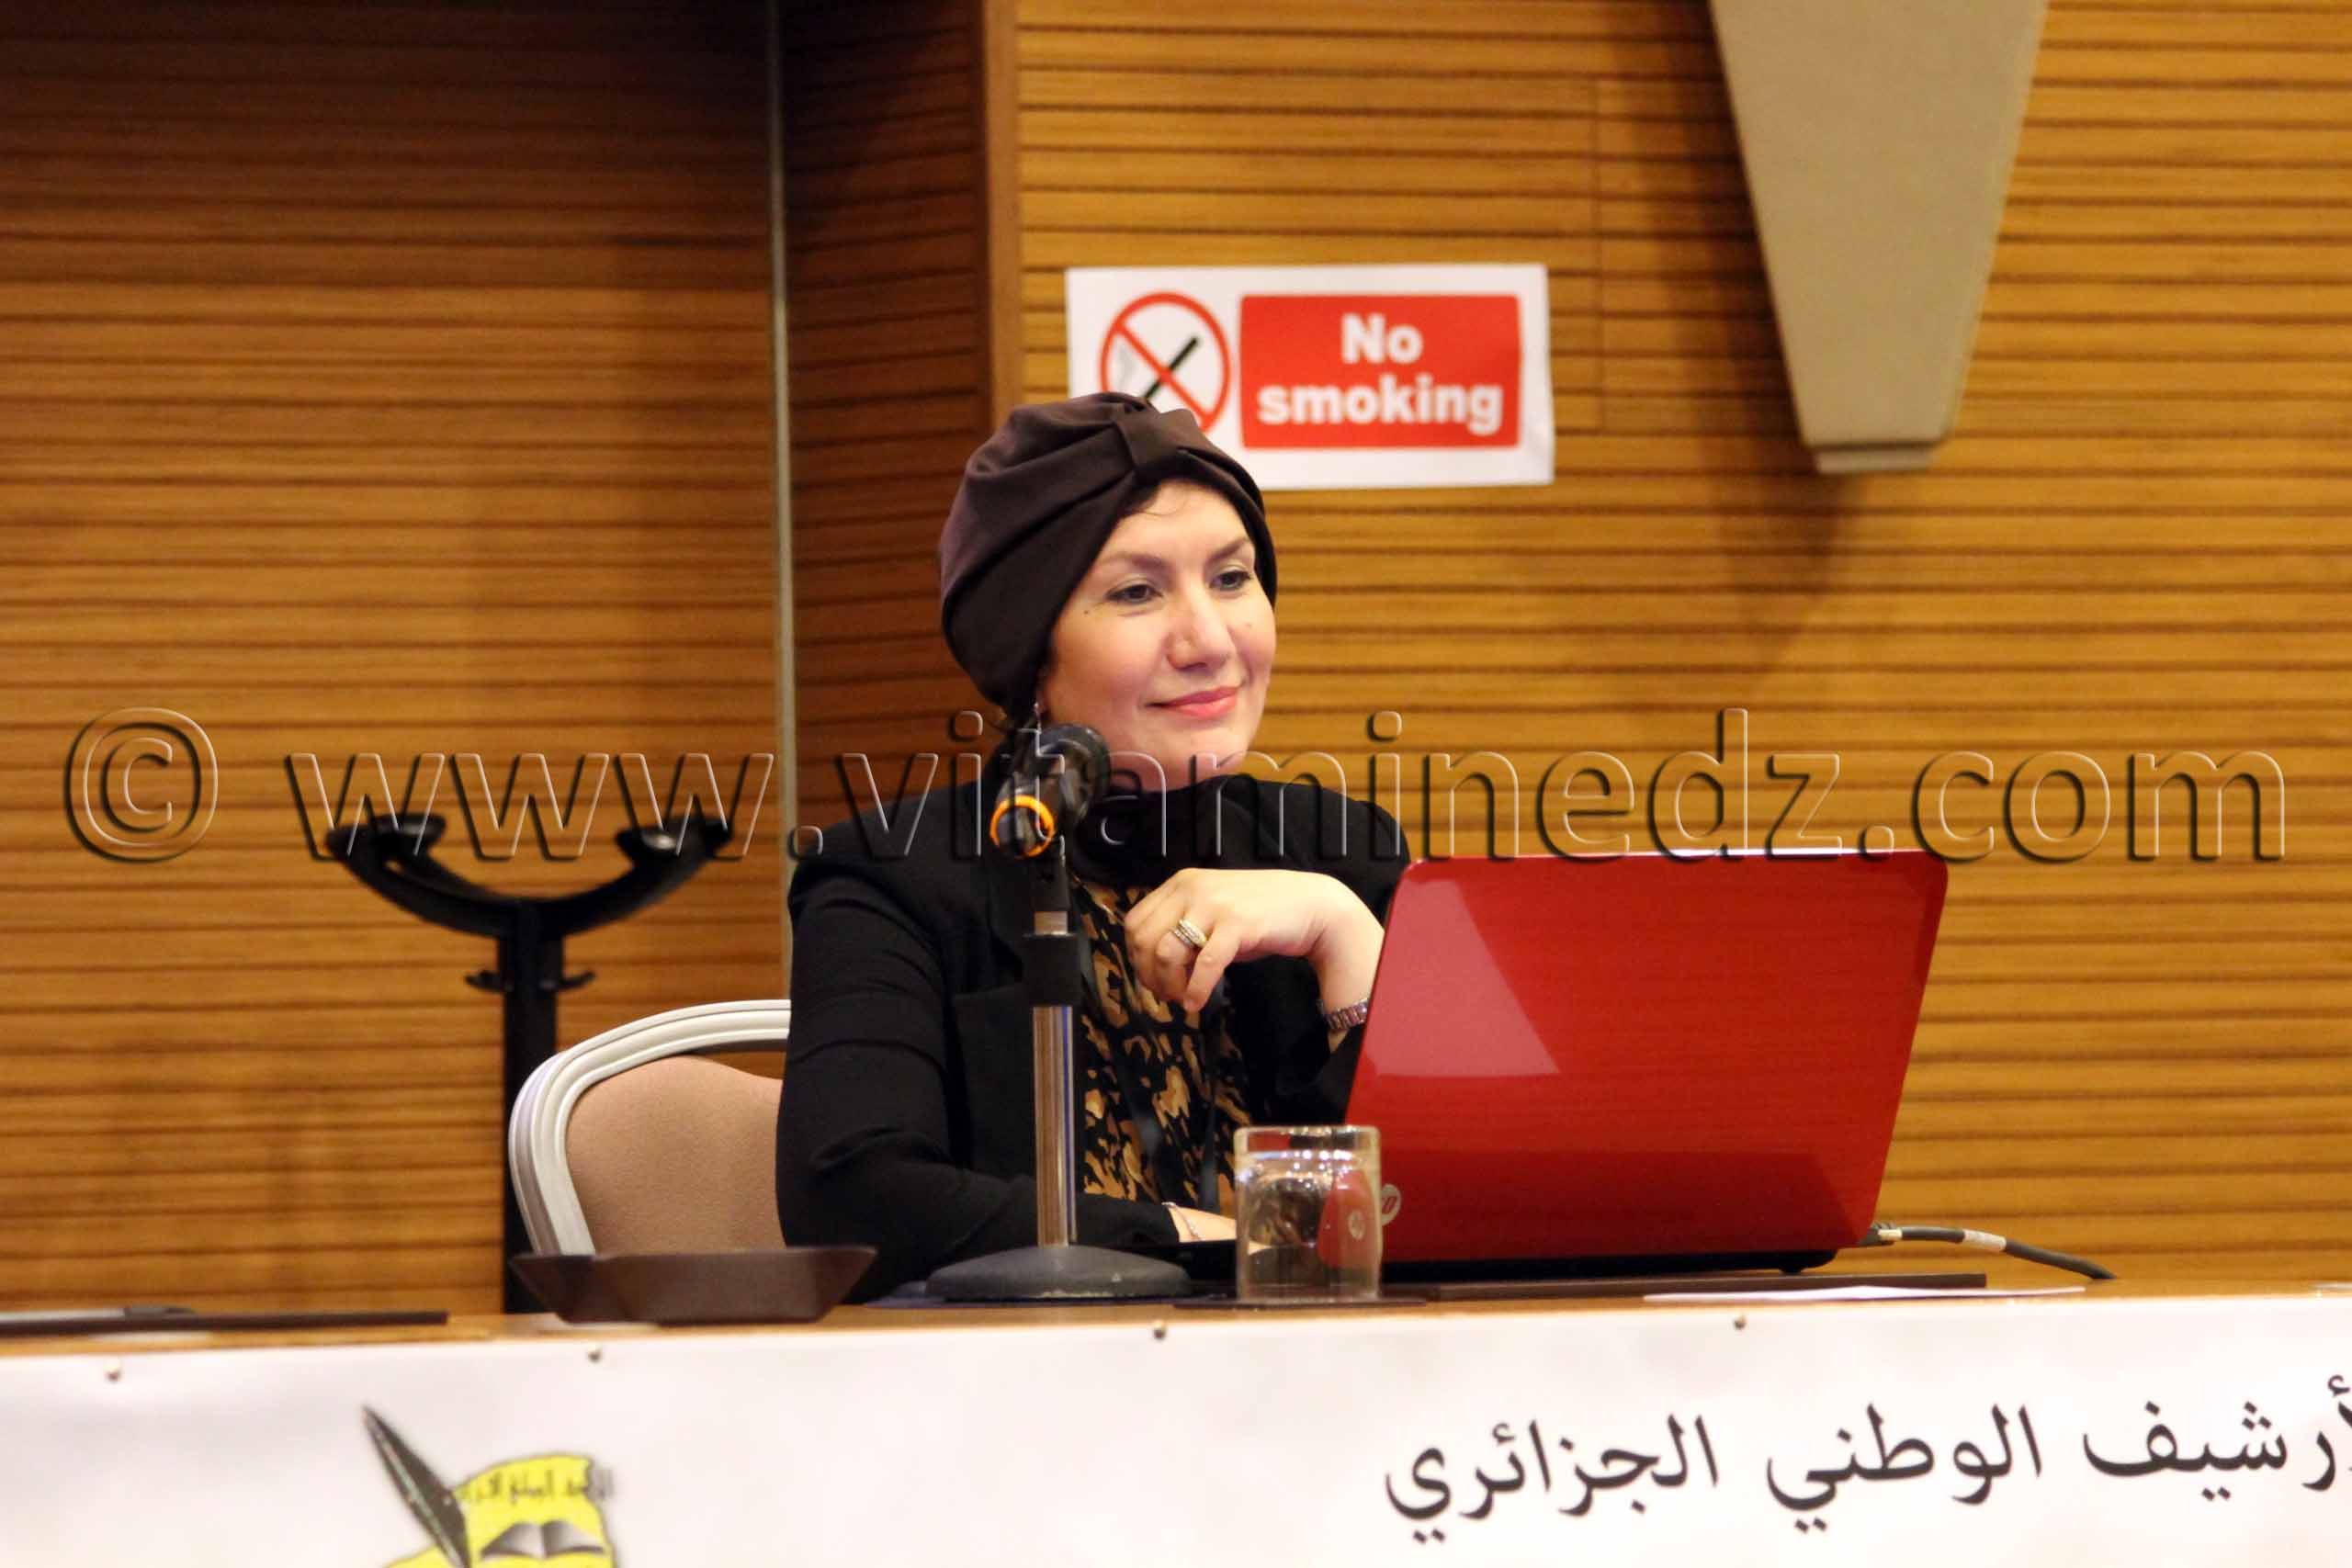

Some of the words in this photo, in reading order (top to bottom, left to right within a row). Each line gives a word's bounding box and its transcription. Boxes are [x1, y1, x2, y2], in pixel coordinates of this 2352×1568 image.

[1340, 312, 1424, 365] No
[1256, 373, 1504, 436] smoking
[1385, 1415, 1718, 1544] الجزائري
[1766, 1403, 2042, 1533] الوطني
[2083, 1374, 2352, 1501] أرشيف
